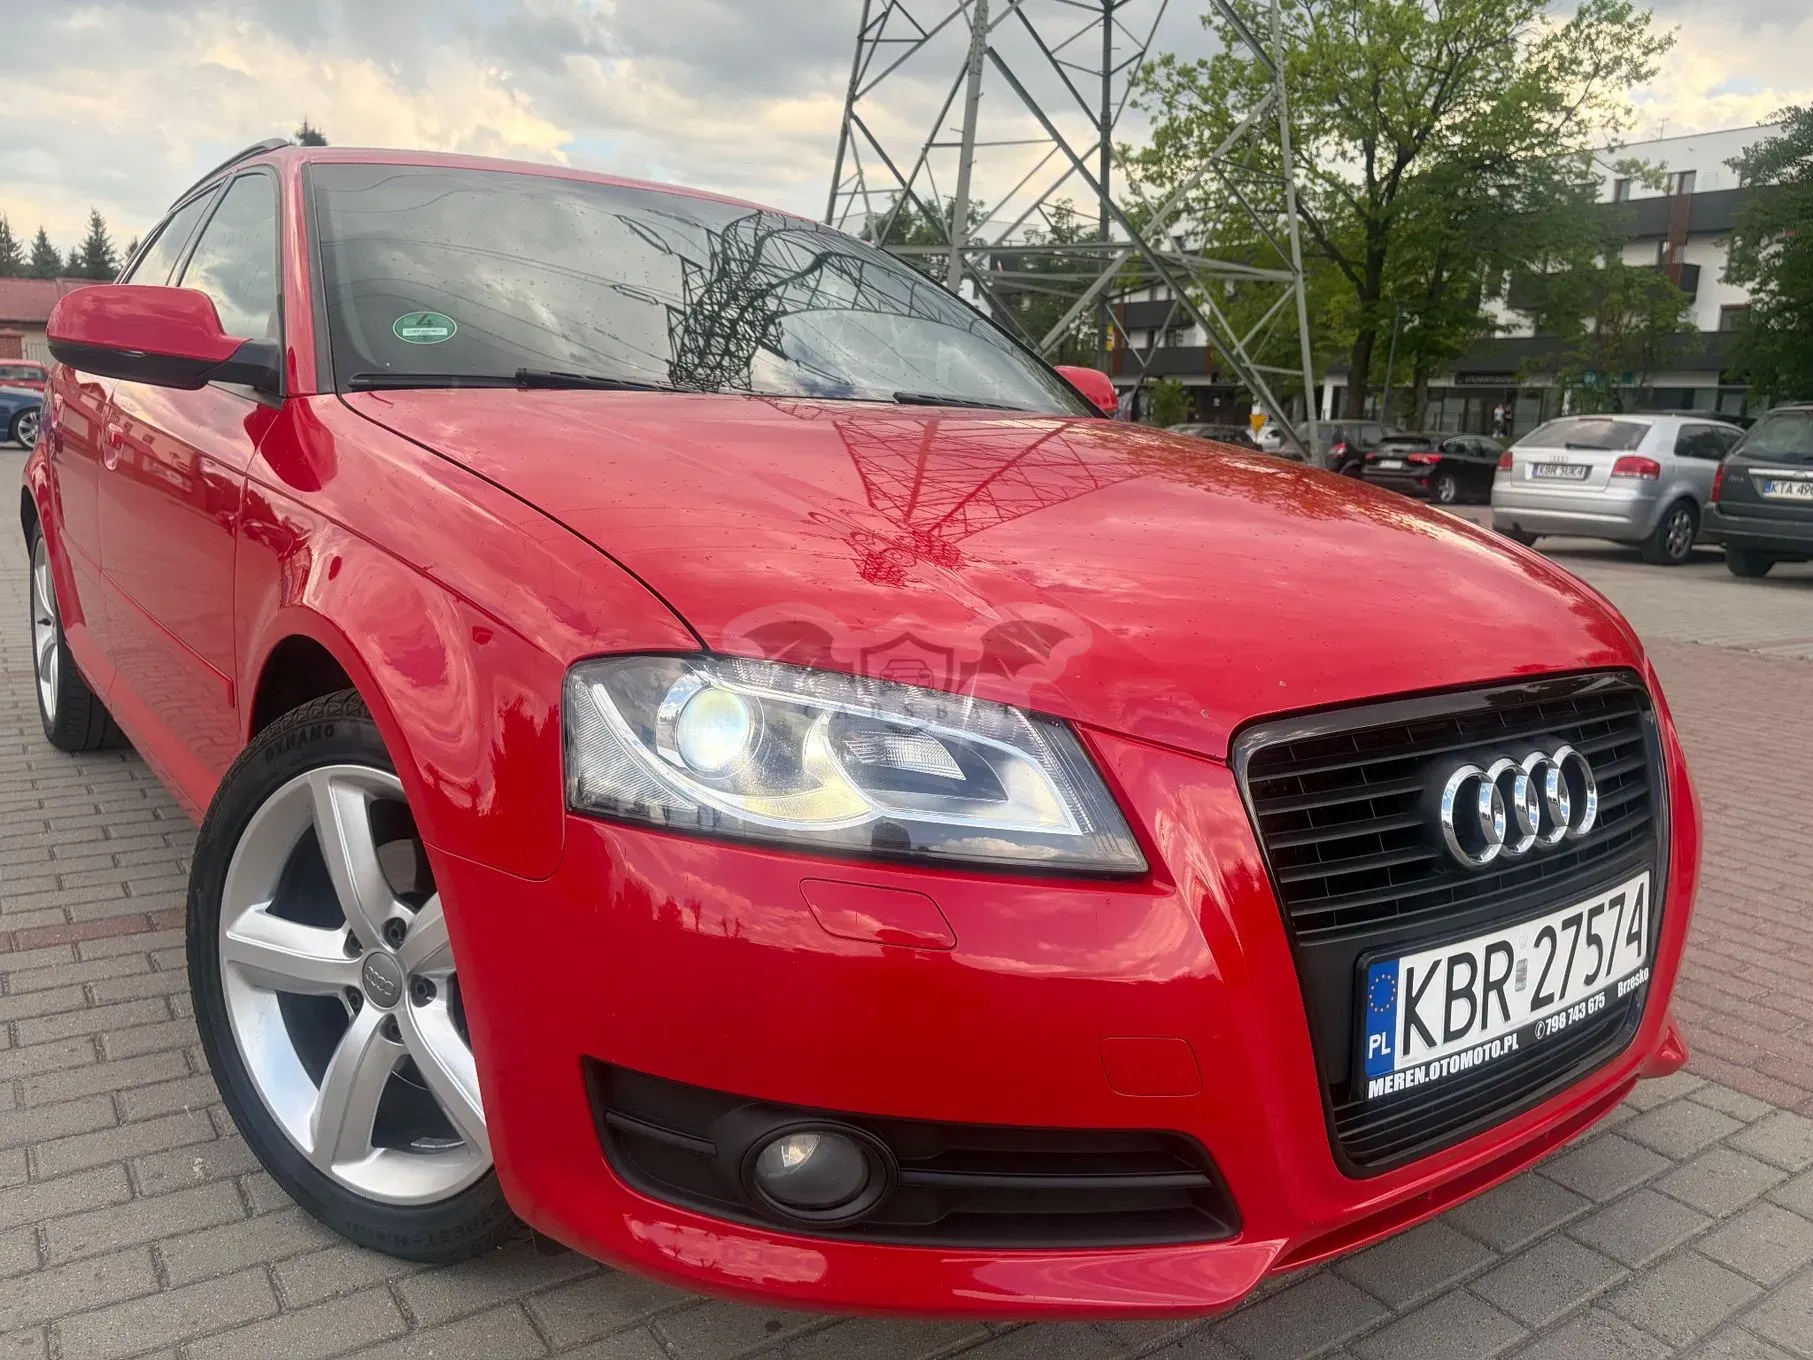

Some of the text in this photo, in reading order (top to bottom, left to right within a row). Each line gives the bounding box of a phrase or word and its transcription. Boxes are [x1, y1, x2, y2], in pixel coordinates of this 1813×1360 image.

[1772, 481, 1793, 495] KTA
[1401, 883, 1644, 1057] KBR 27574
[1368, 967, 1649, 1099] MEREN.OTOMOTO.PL 798 743 675 Brzesko
[1368, 1031, 1391, 1059] PL
